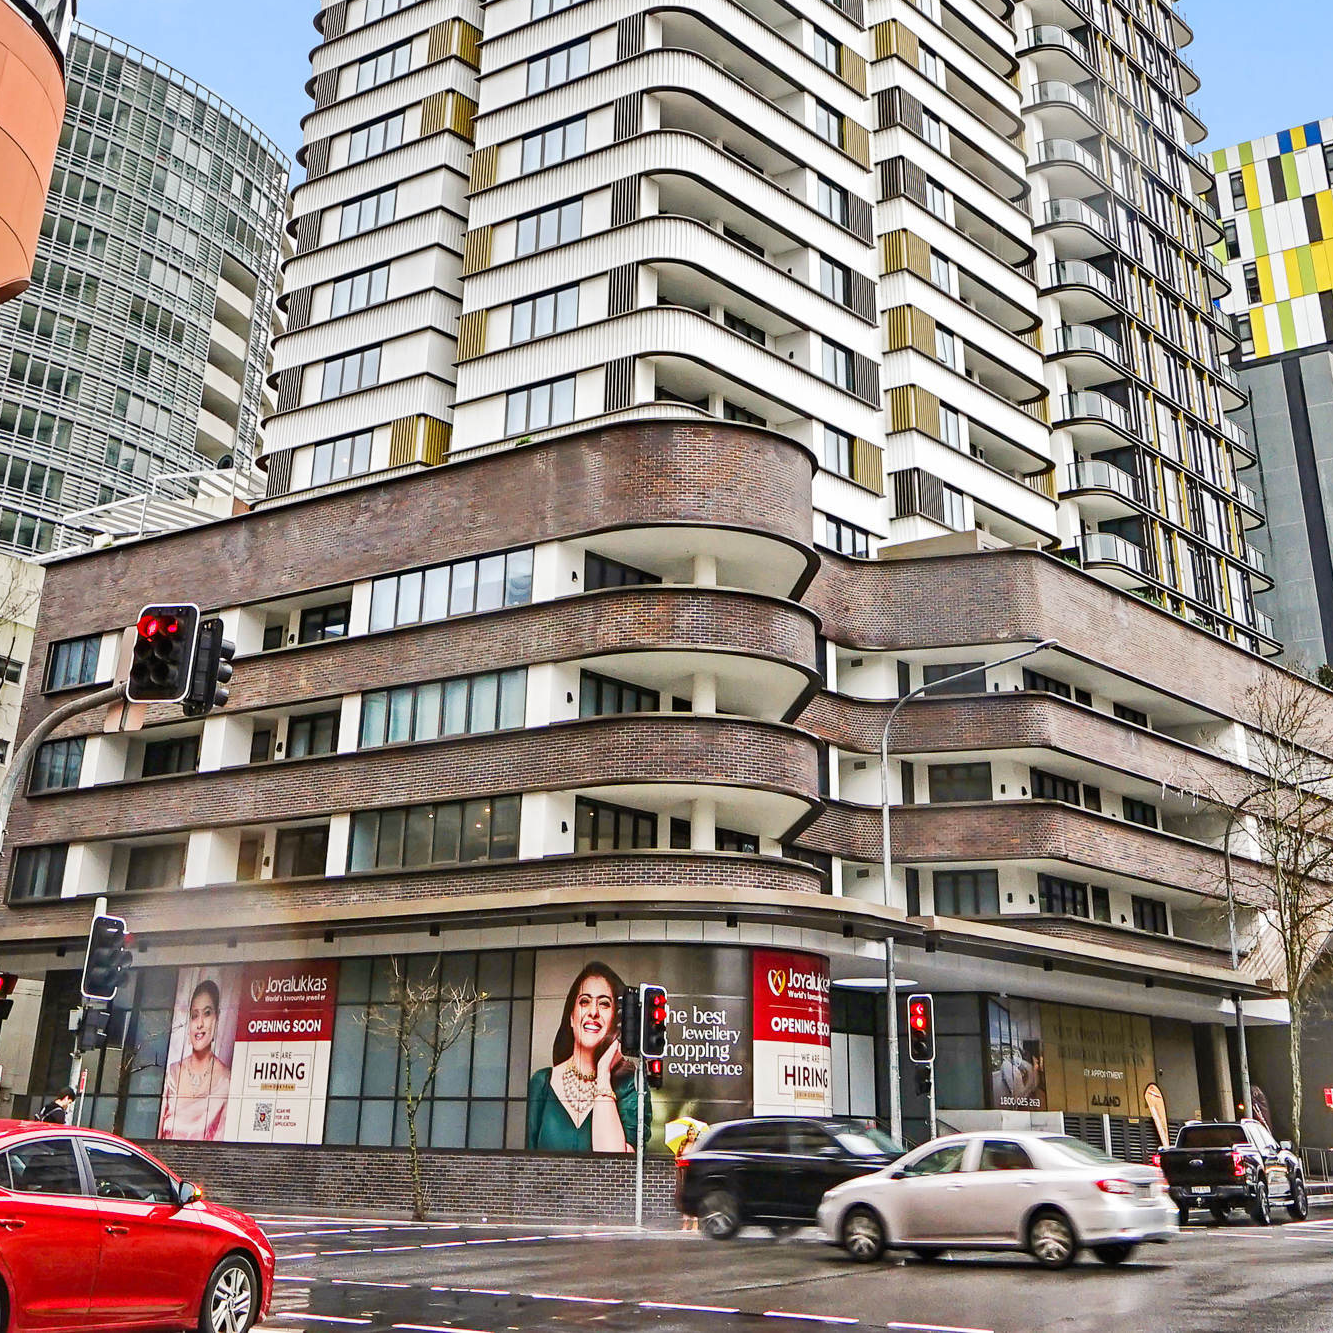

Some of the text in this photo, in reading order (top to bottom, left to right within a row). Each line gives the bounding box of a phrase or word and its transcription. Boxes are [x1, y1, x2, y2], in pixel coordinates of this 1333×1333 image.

[265, 975, 328, 993] Joyalukkas
[666, 1005, 727, 1025] he best
[248, 1019, 322, 1033] OPENING SOON
[770, 1016, 816, 1036] OPENING
[681, 1025, 741, 1045] Jewellery
[270, 1051, 293, 1060] WE ARE
[664, 1041, 730, 1062] hopping
[801, 1053, 820, 1063] WE ARE
[253, 1062, 306, 1080] HIRING
[668, 1061, 743, 1078] experience
[784, 1065, 828, 1088] HIRING
[1091, 1069, 1124, 1080] APPOINTMENT
[1000, 1096, 1016, 1106] 1800
[1017, 1097, 1028, 1107] 025
[1091, 1094, 1121, 1108] ALAND
